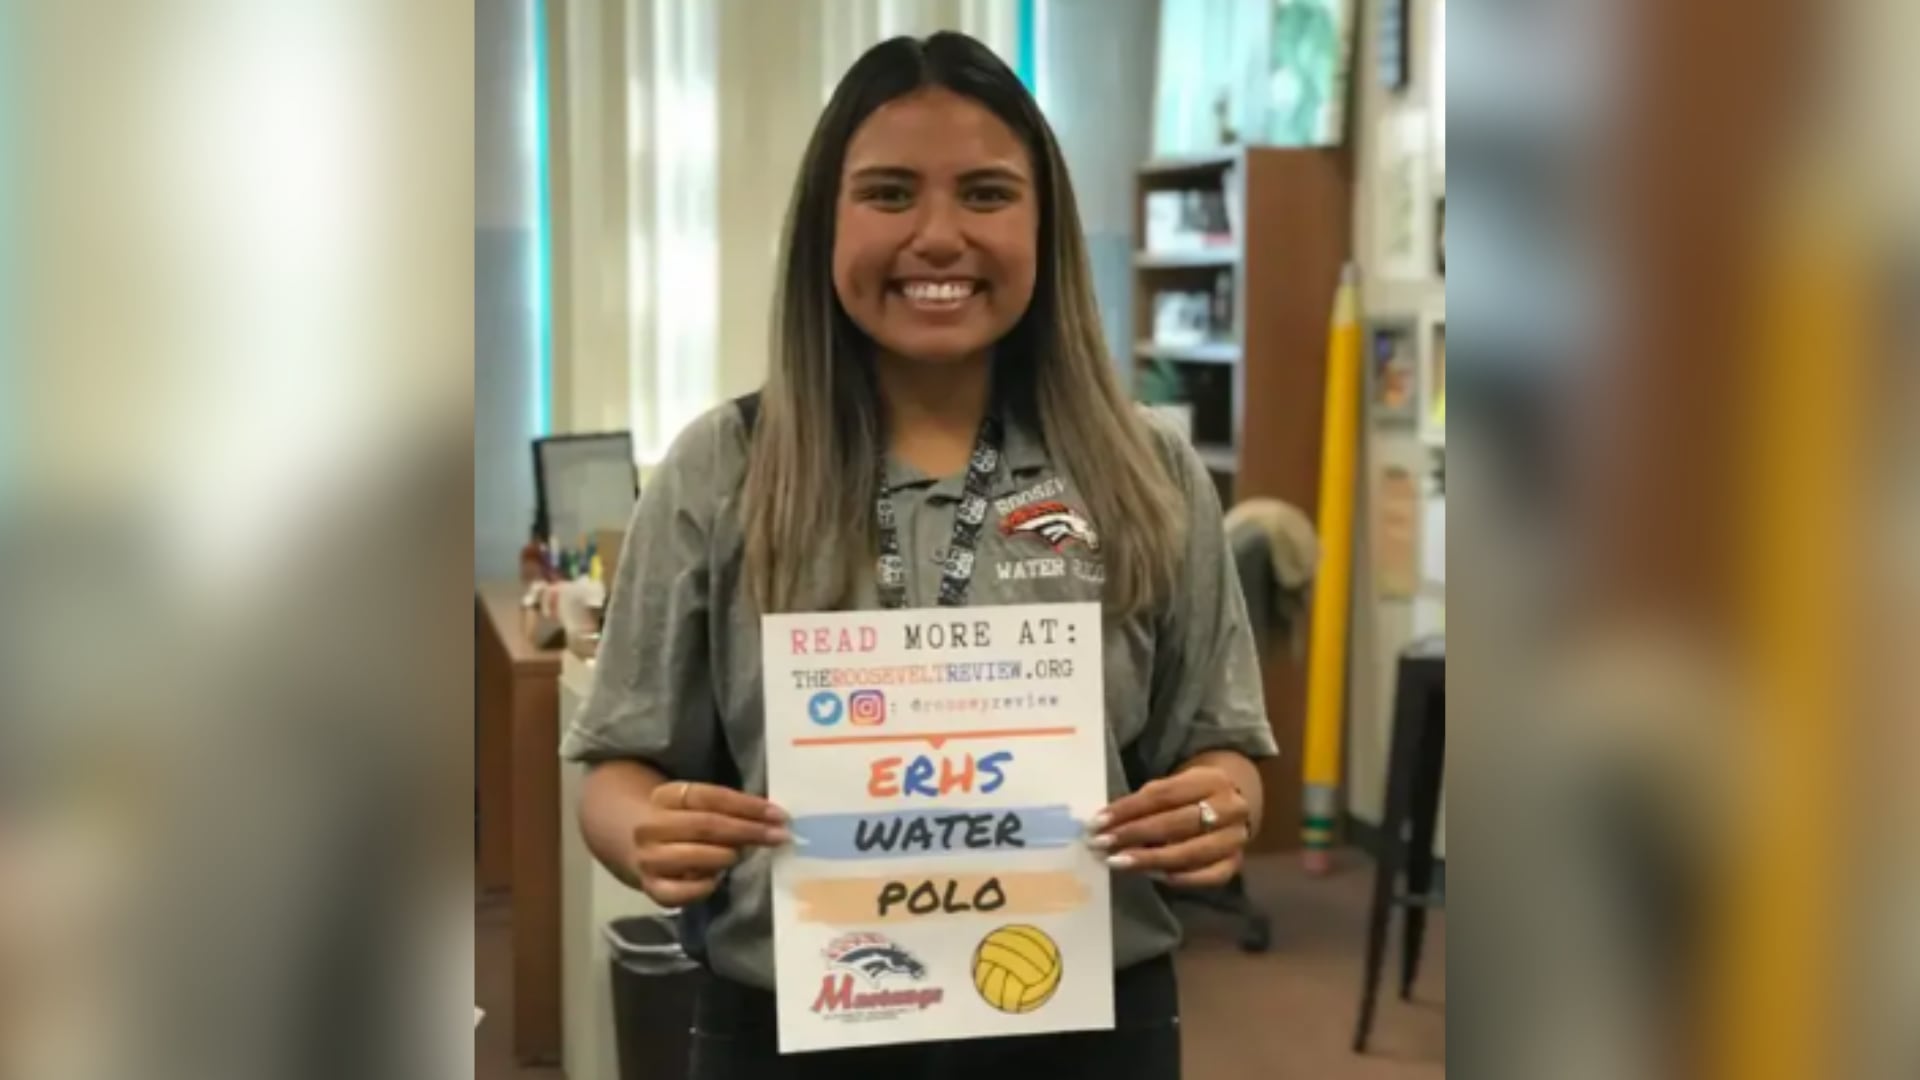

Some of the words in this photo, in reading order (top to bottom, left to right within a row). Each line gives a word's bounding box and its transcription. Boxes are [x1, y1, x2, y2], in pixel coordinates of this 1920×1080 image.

[995, 558, 1067, 580] WATER
[791, 627, 878, 654] READ
[904, 621, 992, 650] MORE
[1018, 619, 1078, 645] AT:
[791, 659, 1074, 689] THEROOSEVELTREVIEW.ORG
[867, 751, 1014, 797] ERHS
[854, 812, 1026, 851] WATER
[877, 877, 1006, 916] POLO
